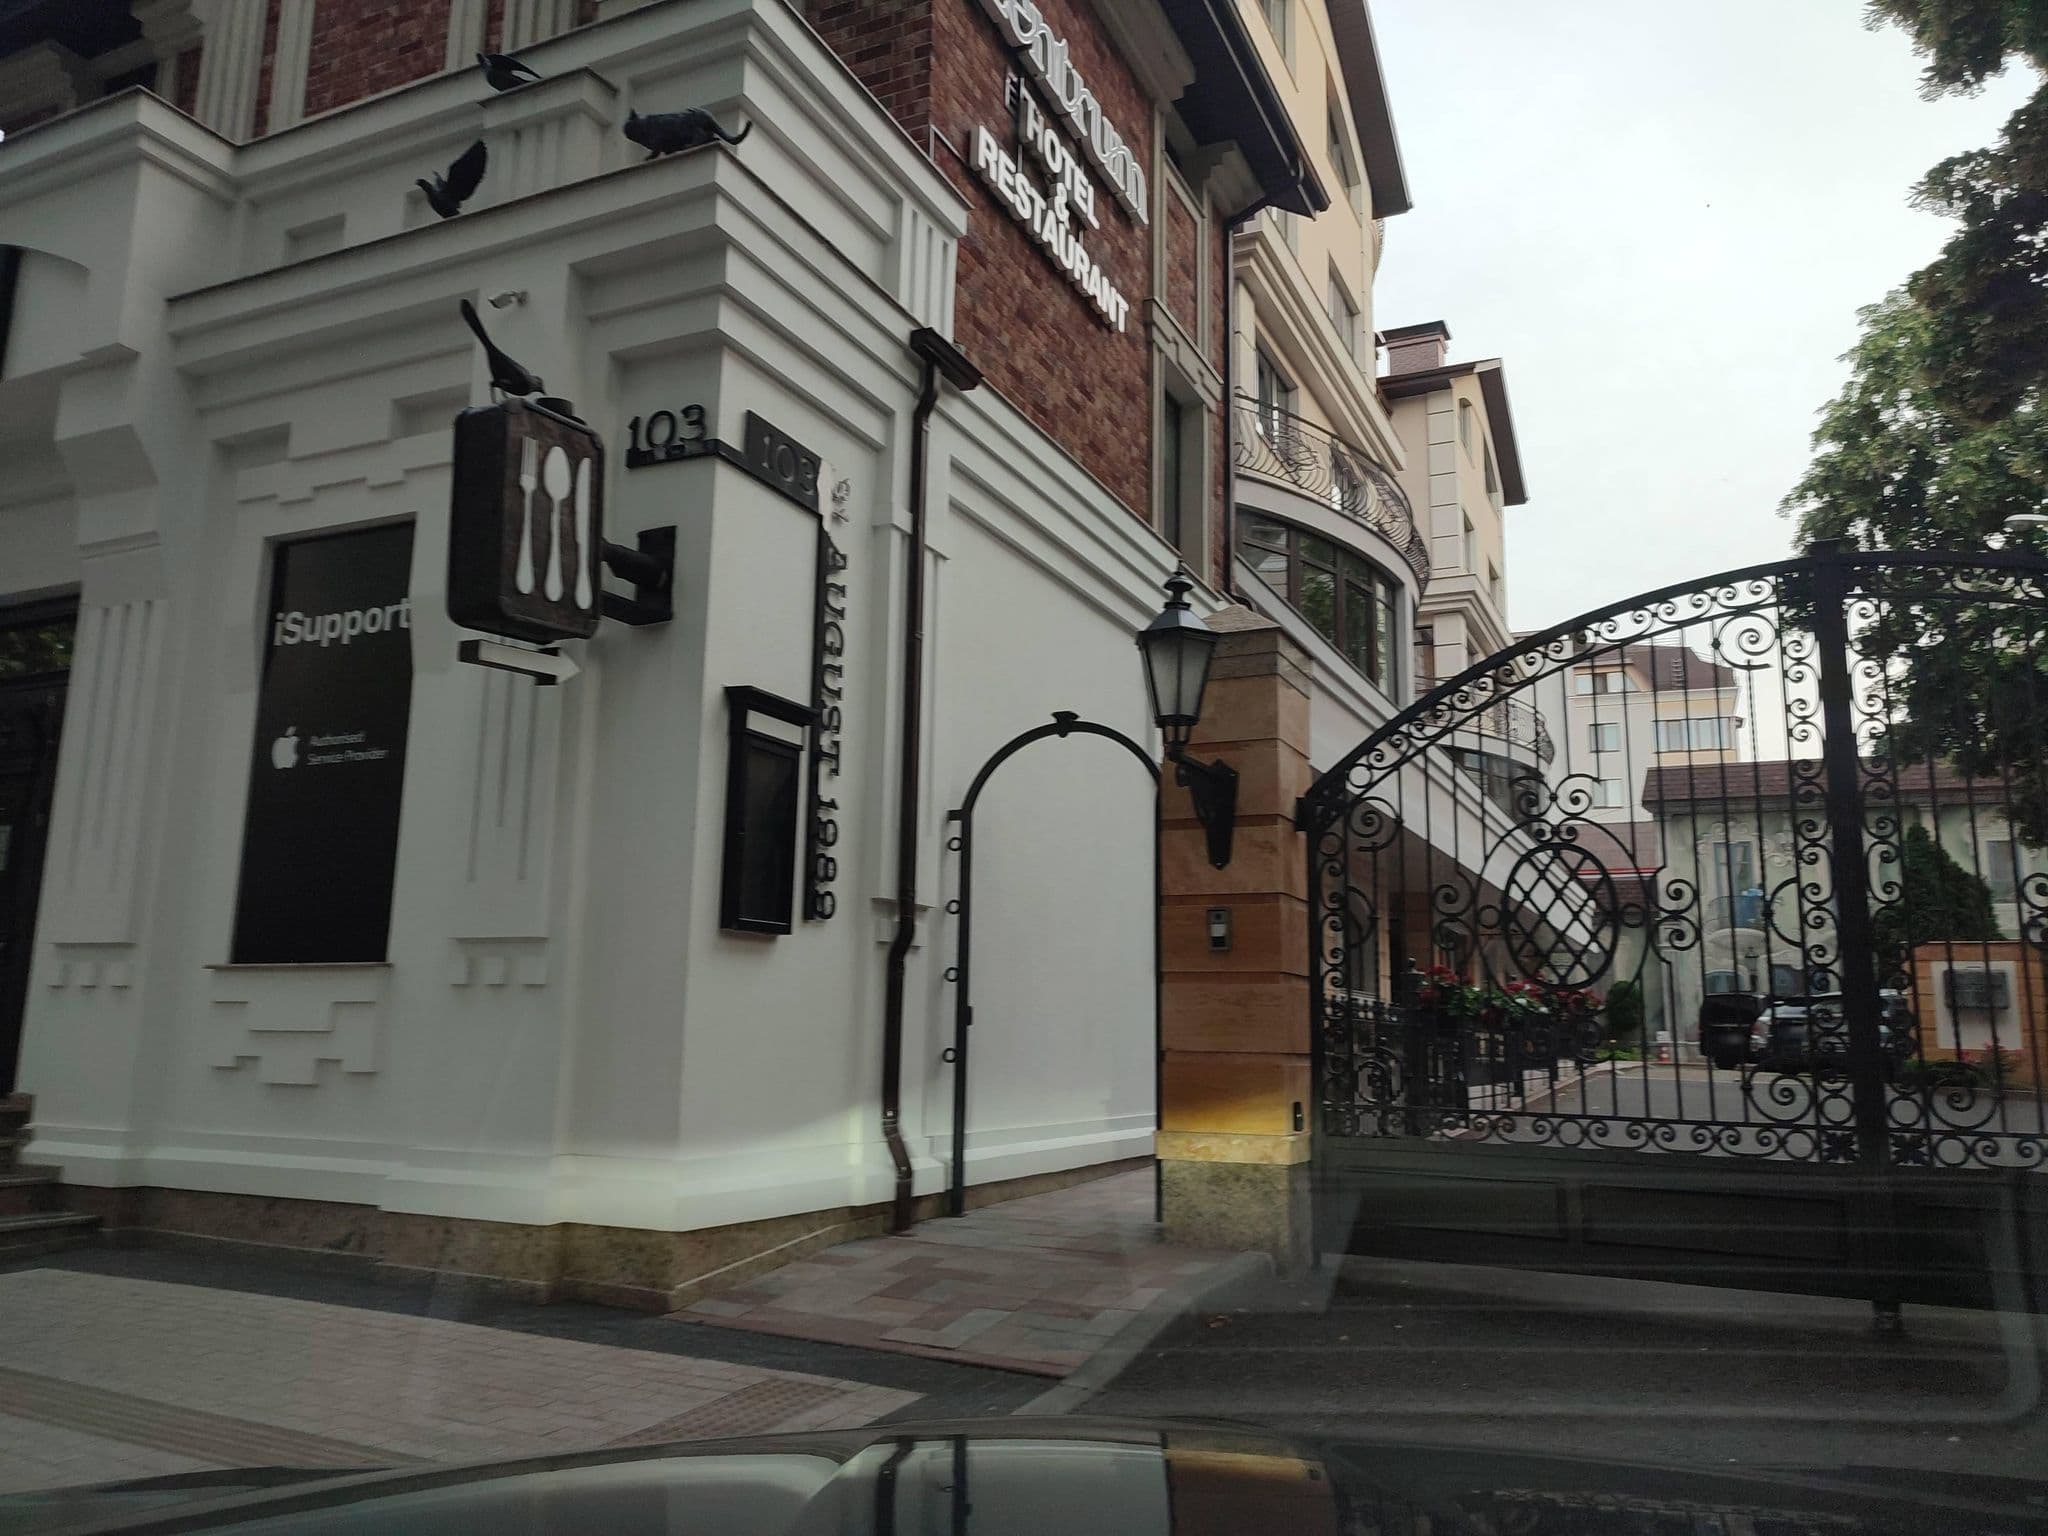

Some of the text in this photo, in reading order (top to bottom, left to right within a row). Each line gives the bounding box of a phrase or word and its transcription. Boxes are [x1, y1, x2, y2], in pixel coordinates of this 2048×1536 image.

[978, 125, 1129, 333] RESTAURANT
[627, 403, 706, 456] 103
[761, 434, 818, 497] 103
[273, 597, 413, 648] iSupport
[820, 545, 847, 776] AUGUST
